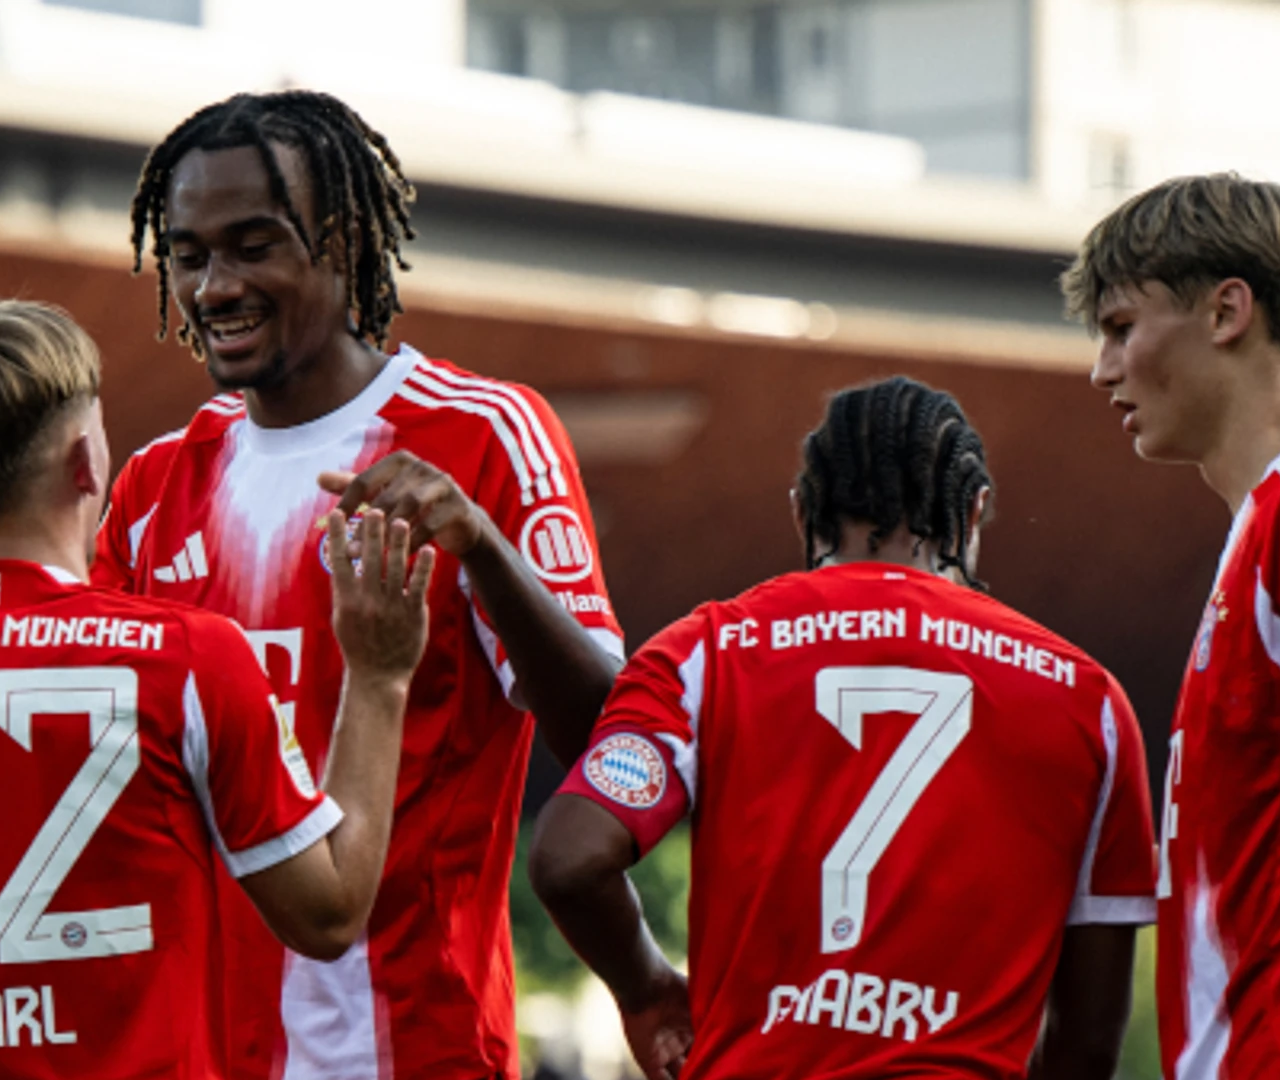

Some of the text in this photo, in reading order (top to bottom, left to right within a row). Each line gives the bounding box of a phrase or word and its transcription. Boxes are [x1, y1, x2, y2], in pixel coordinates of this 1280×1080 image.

[1, 615, 163, 651] MÜNCHEN
[719, 607, 1077, 688] FC BAYERN MÜNCHEN
[815, 665, 974, 955] 7
